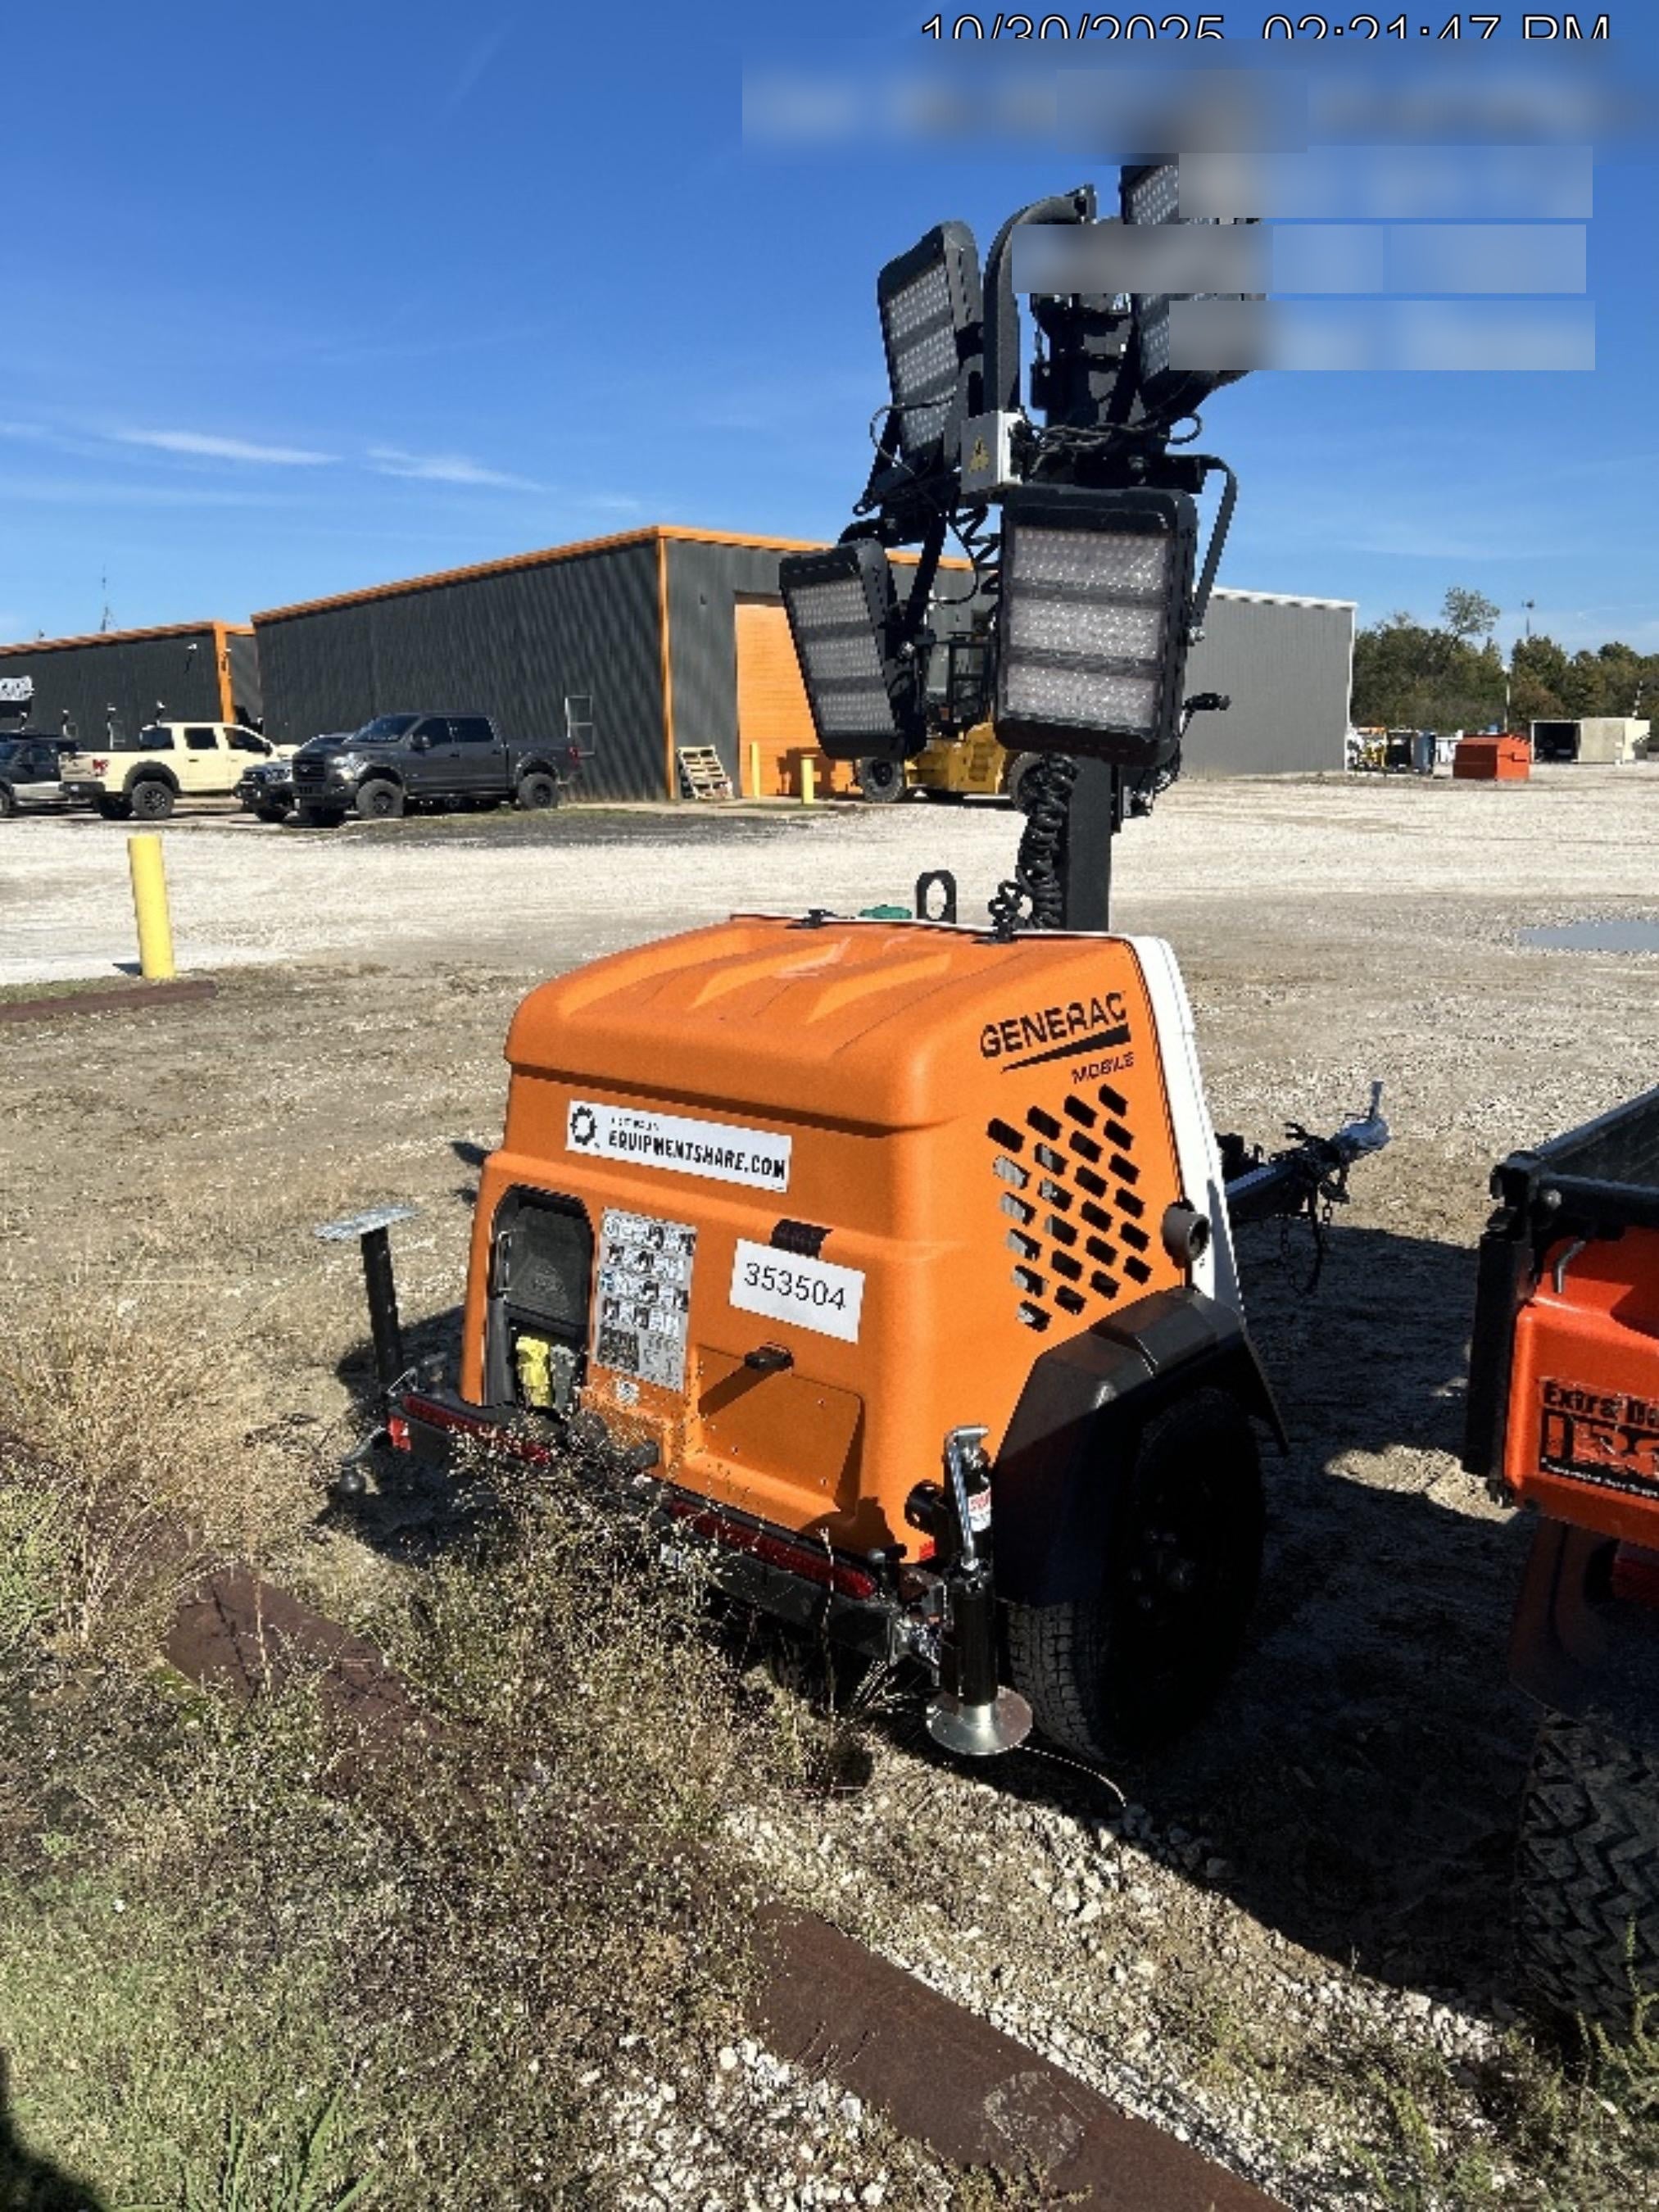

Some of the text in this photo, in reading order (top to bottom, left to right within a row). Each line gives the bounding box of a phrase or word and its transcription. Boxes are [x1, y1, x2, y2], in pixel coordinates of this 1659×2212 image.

[980, 990, 1127, 1059] GENERAC
[1071, 1051, 1135, 1085] MOBILE
[609, 1129, 786, 1181] EQUIPMENTSHARE.COM
[742, 1262, 847, 1312] 353504
